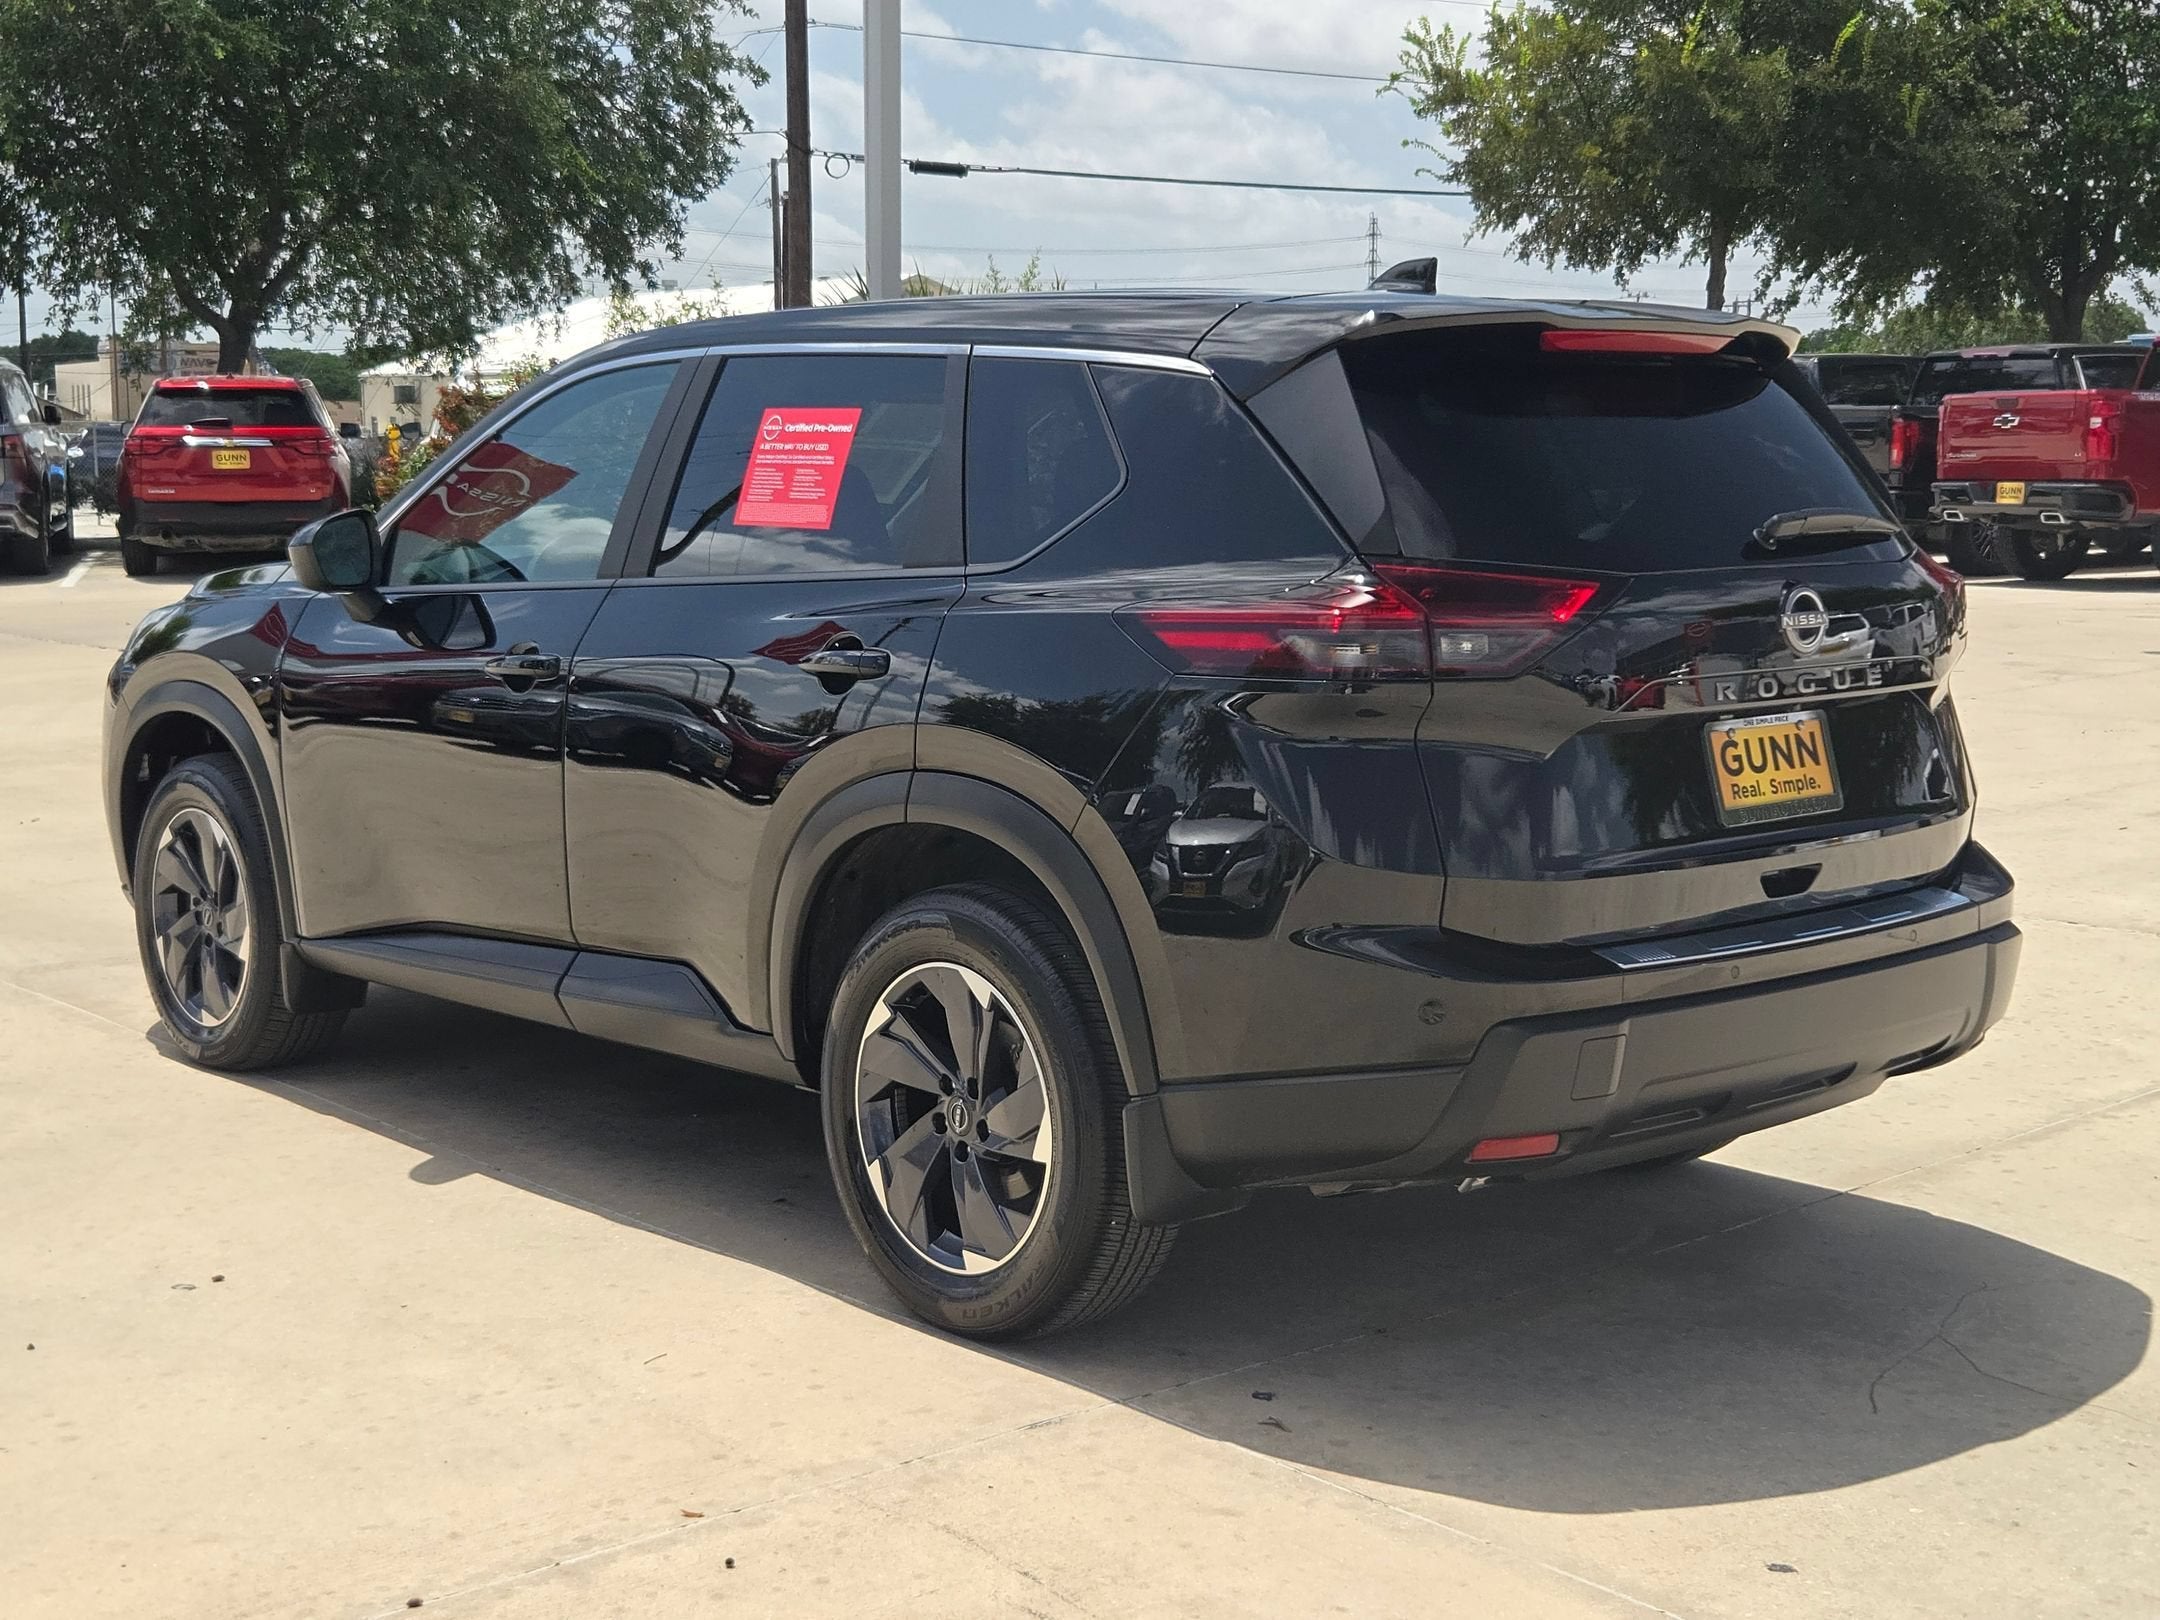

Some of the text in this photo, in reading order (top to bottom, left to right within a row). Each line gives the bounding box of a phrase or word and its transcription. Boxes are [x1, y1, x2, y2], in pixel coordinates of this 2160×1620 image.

[785, 423, 853, 433] Certified Pre-Owned
[216, 454, 247, 462] GUNN
[2000, 486, 2022, 495] GUNN
[1783, 613, 1827, 626] NISSAN
[1715, 664, 1883, 702] ROGUE
[1743, 715, 1789, 727] ONE SIMPLE PRICE
[1720, 731, 1821, 777] GUNN
[1730, 774, 1821, 800] Real. Simple.
